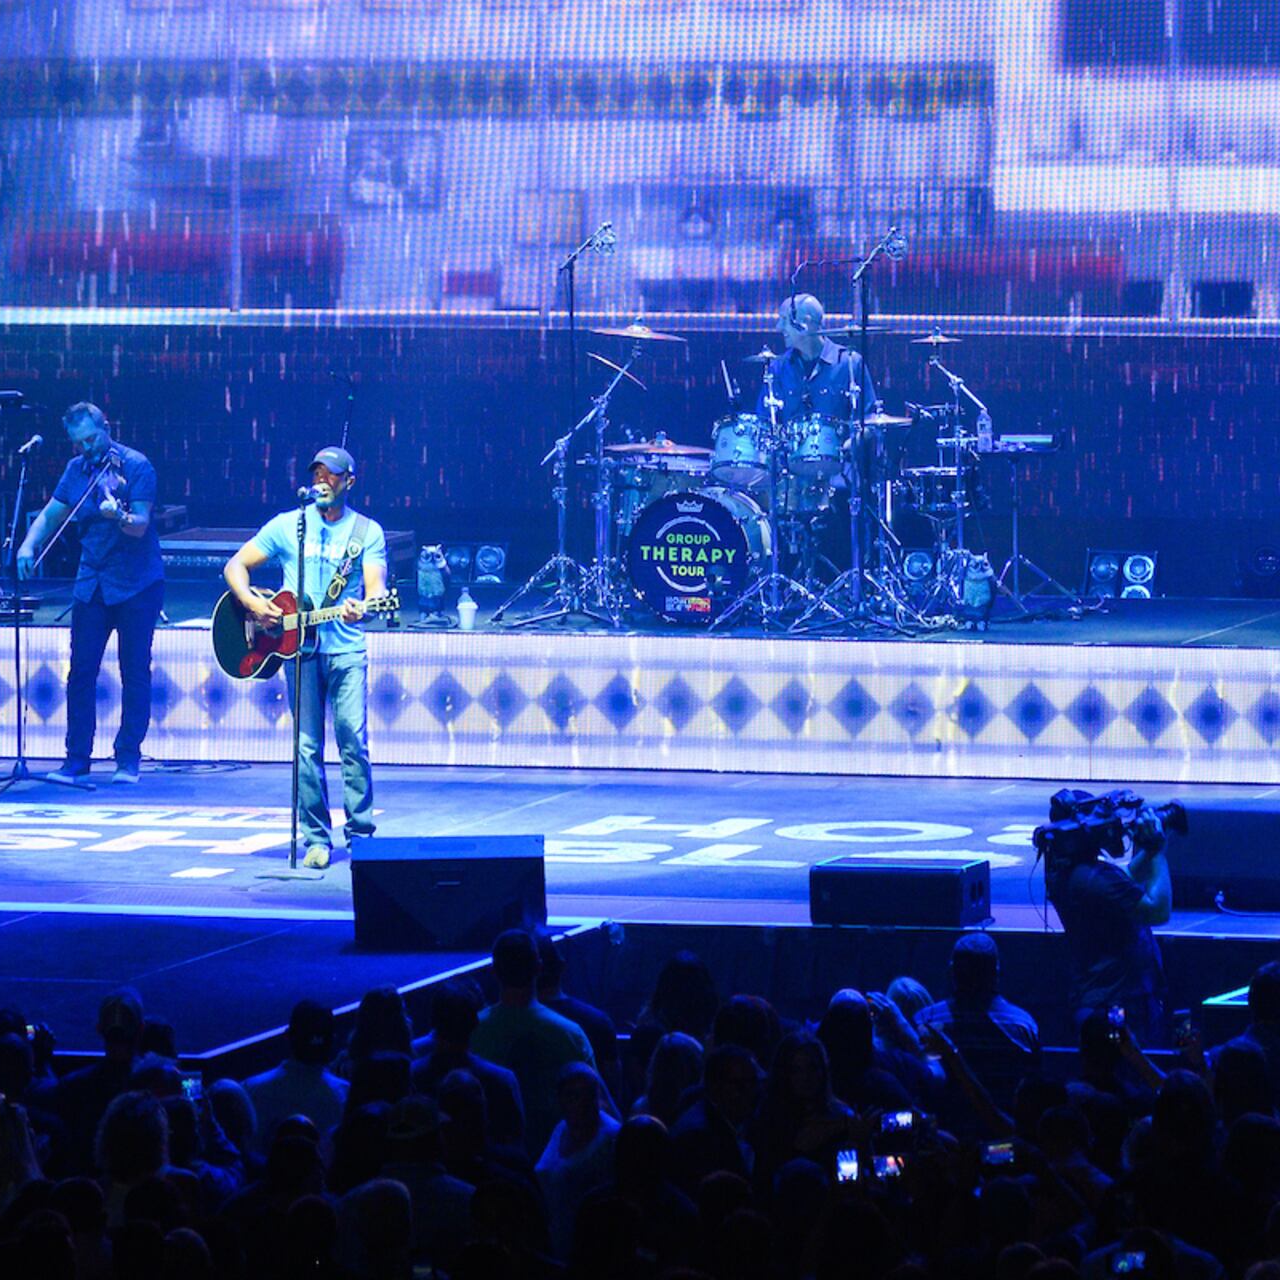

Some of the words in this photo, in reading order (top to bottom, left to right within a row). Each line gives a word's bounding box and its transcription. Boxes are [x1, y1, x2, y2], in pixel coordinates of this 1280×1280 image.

[666, 533, 711, 545] GROUP
[640, 546, 736, 563] THERAPY
[671, 565, 705, 576] TOUR
